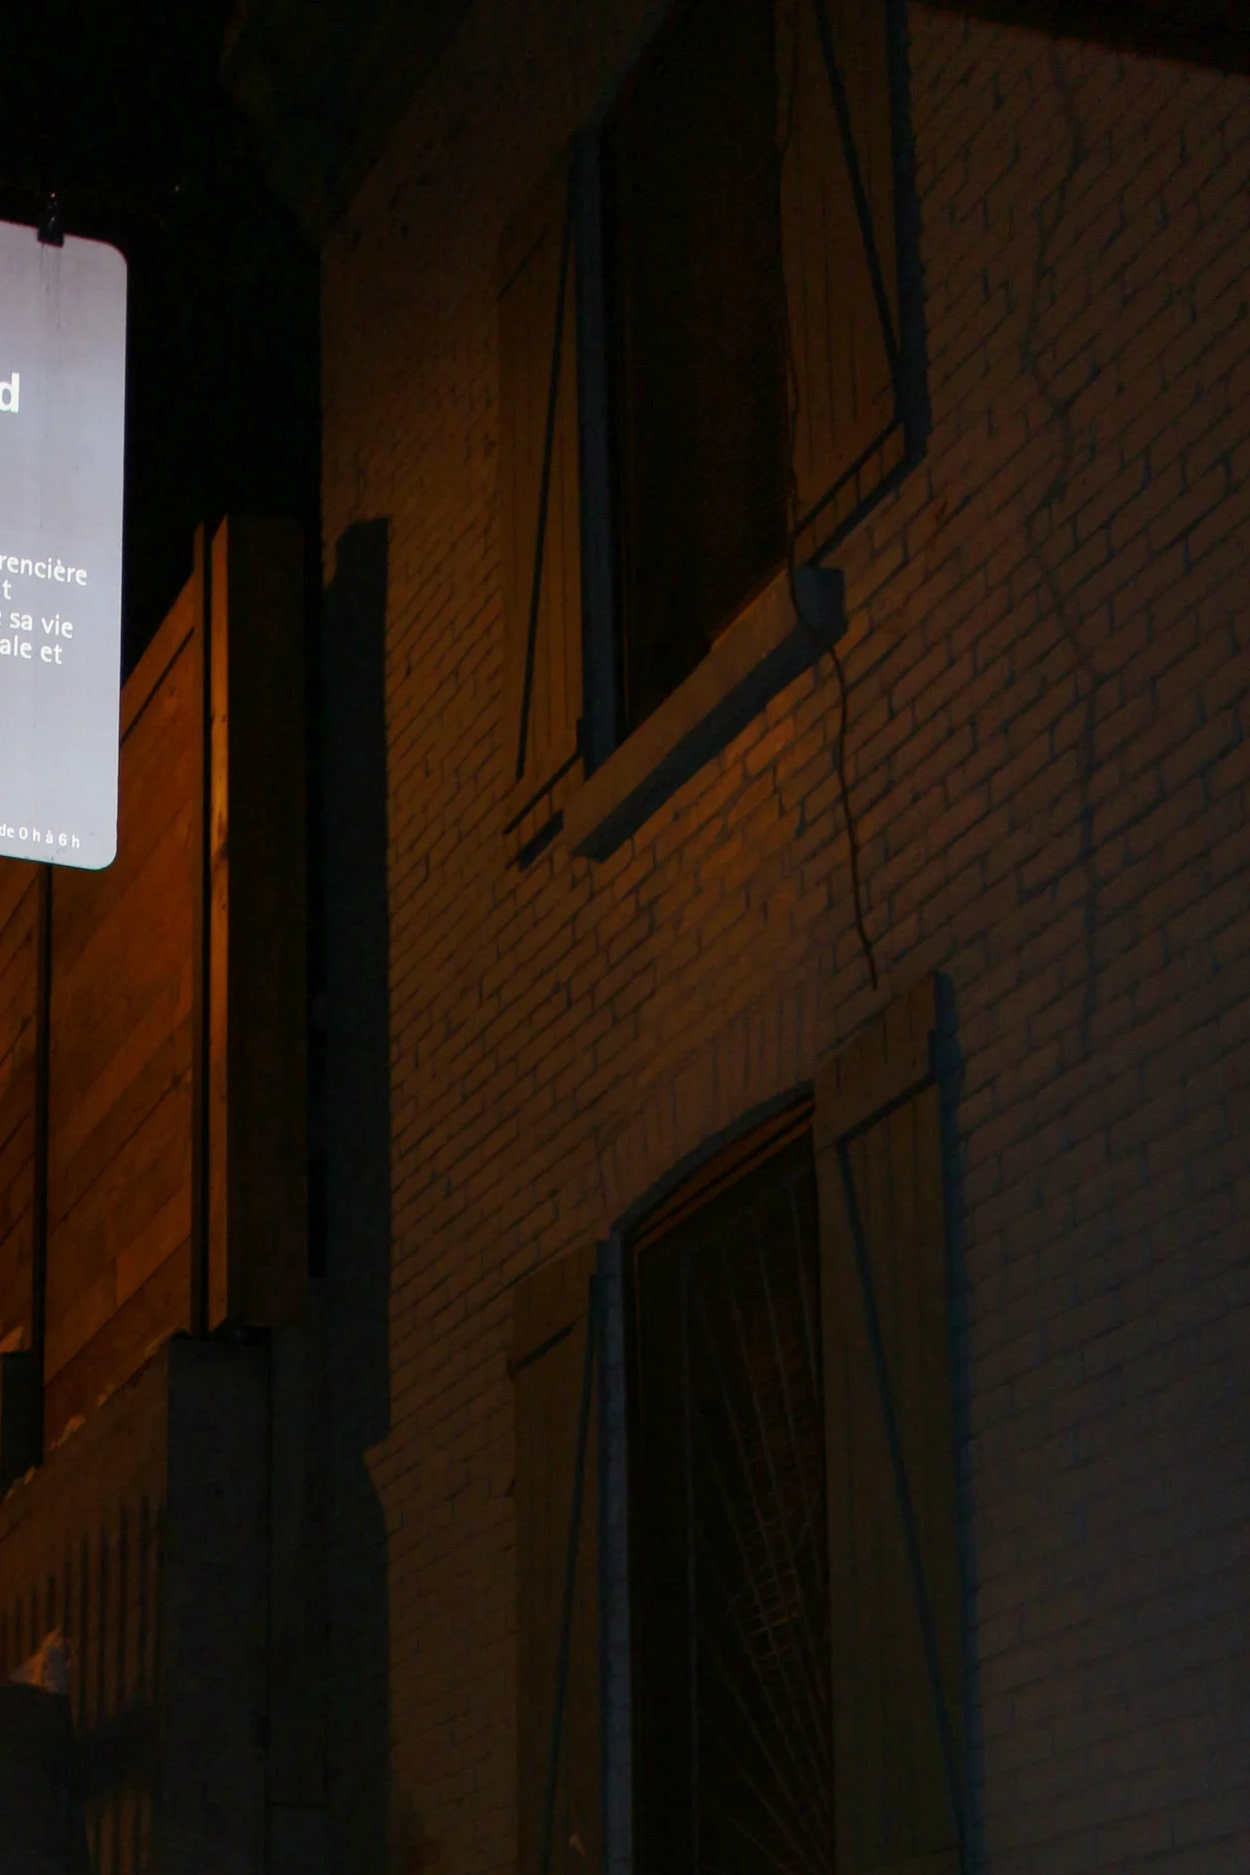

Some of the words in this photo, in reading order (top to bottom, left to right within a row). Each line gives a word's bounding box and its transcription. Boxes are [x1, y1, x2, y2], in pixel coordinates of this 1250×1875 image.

[9, 612, 33, 632] sa
[41, 613, 74, 639] vie
[40, 643, 63, 665] et
